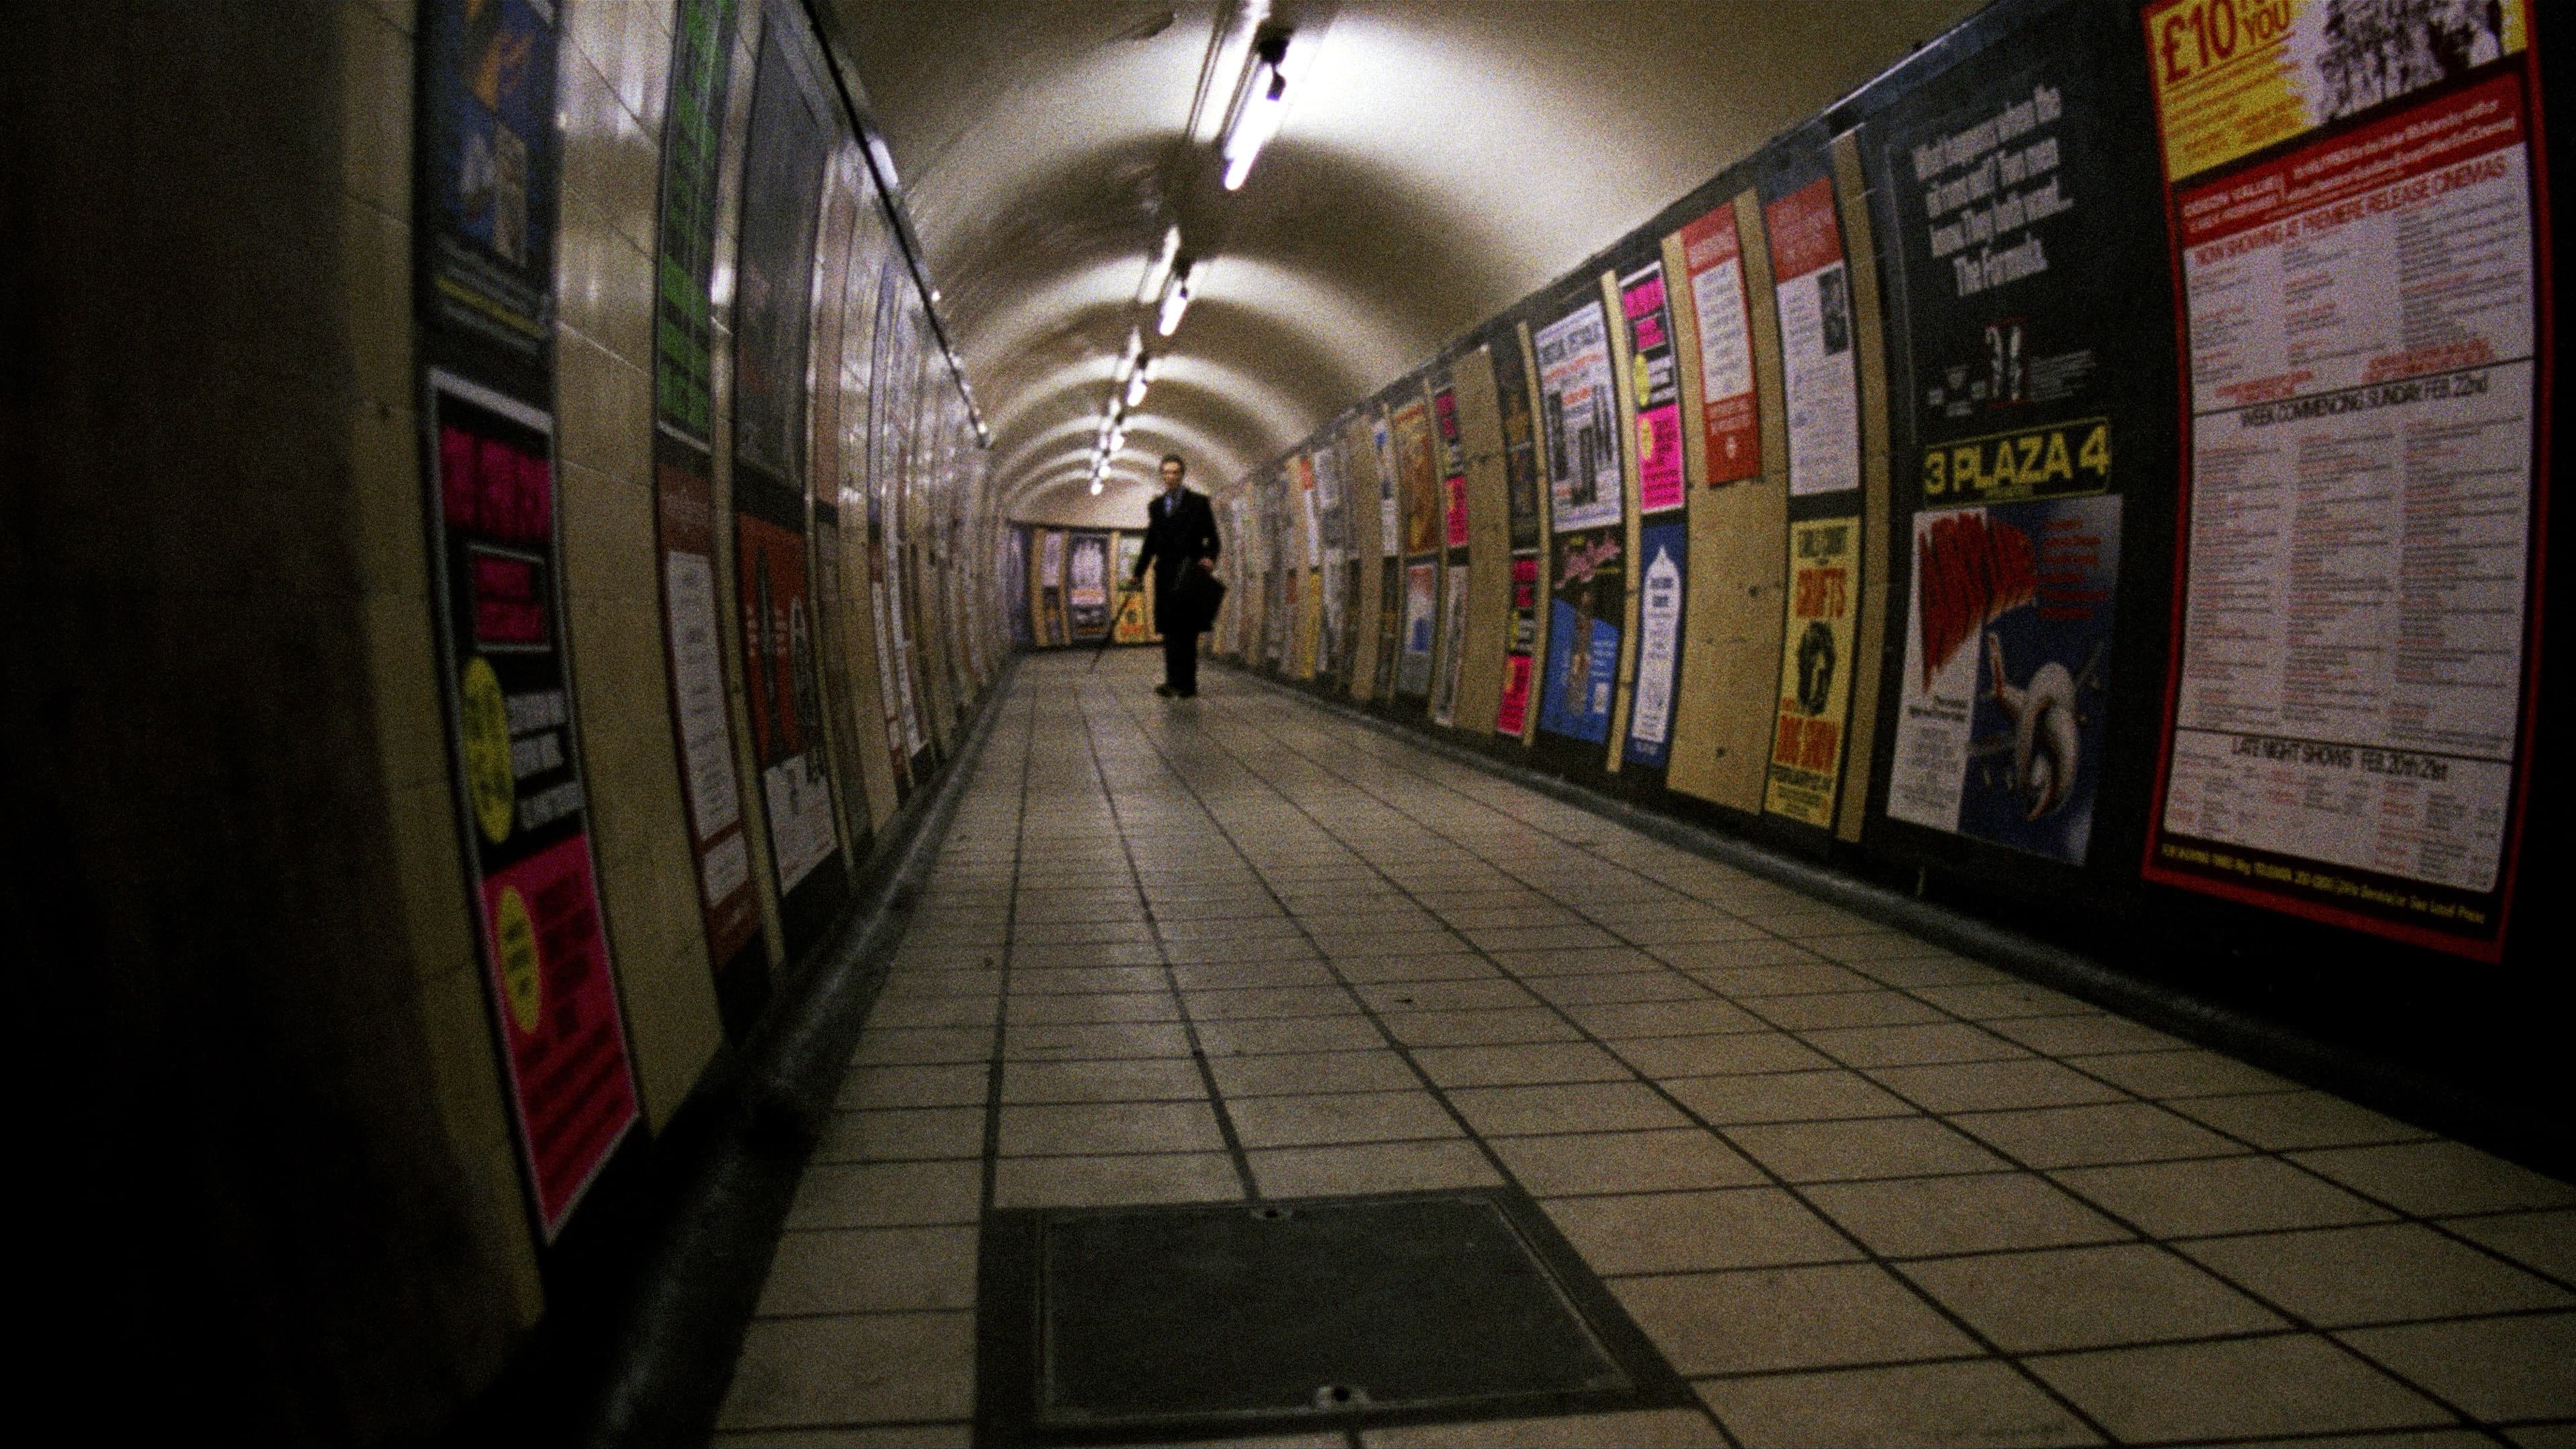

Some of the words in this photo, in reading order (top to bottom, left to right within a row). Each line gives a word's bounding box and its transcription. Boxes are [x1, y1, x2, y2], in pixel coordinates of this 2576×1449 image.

[2161, 0, 2236, 83] £10
[2242, 0, 2290, 45] YOU
[2223, 227, 2282, 256] SHOWING
[2365, 180, 2430, 214] RELEASE
[2430, 156, 2507, 195] CINEMAS
[1953, 256, 1982, 297] The
[2276, 392, 2363, 422] COMMENCING
[2364, 382, 2422, 409] SUNDAY
[1925, 451, 1945, 495] 3
[1953, 431, 2073, 492] PLAZA
[2079, 425, 2110, 476] 4
[2231, 737, 2259, 757] LATE
[2262, 739, 2300, 762] NIGHT
[2302, 745, 2352, 769] SHOWS
